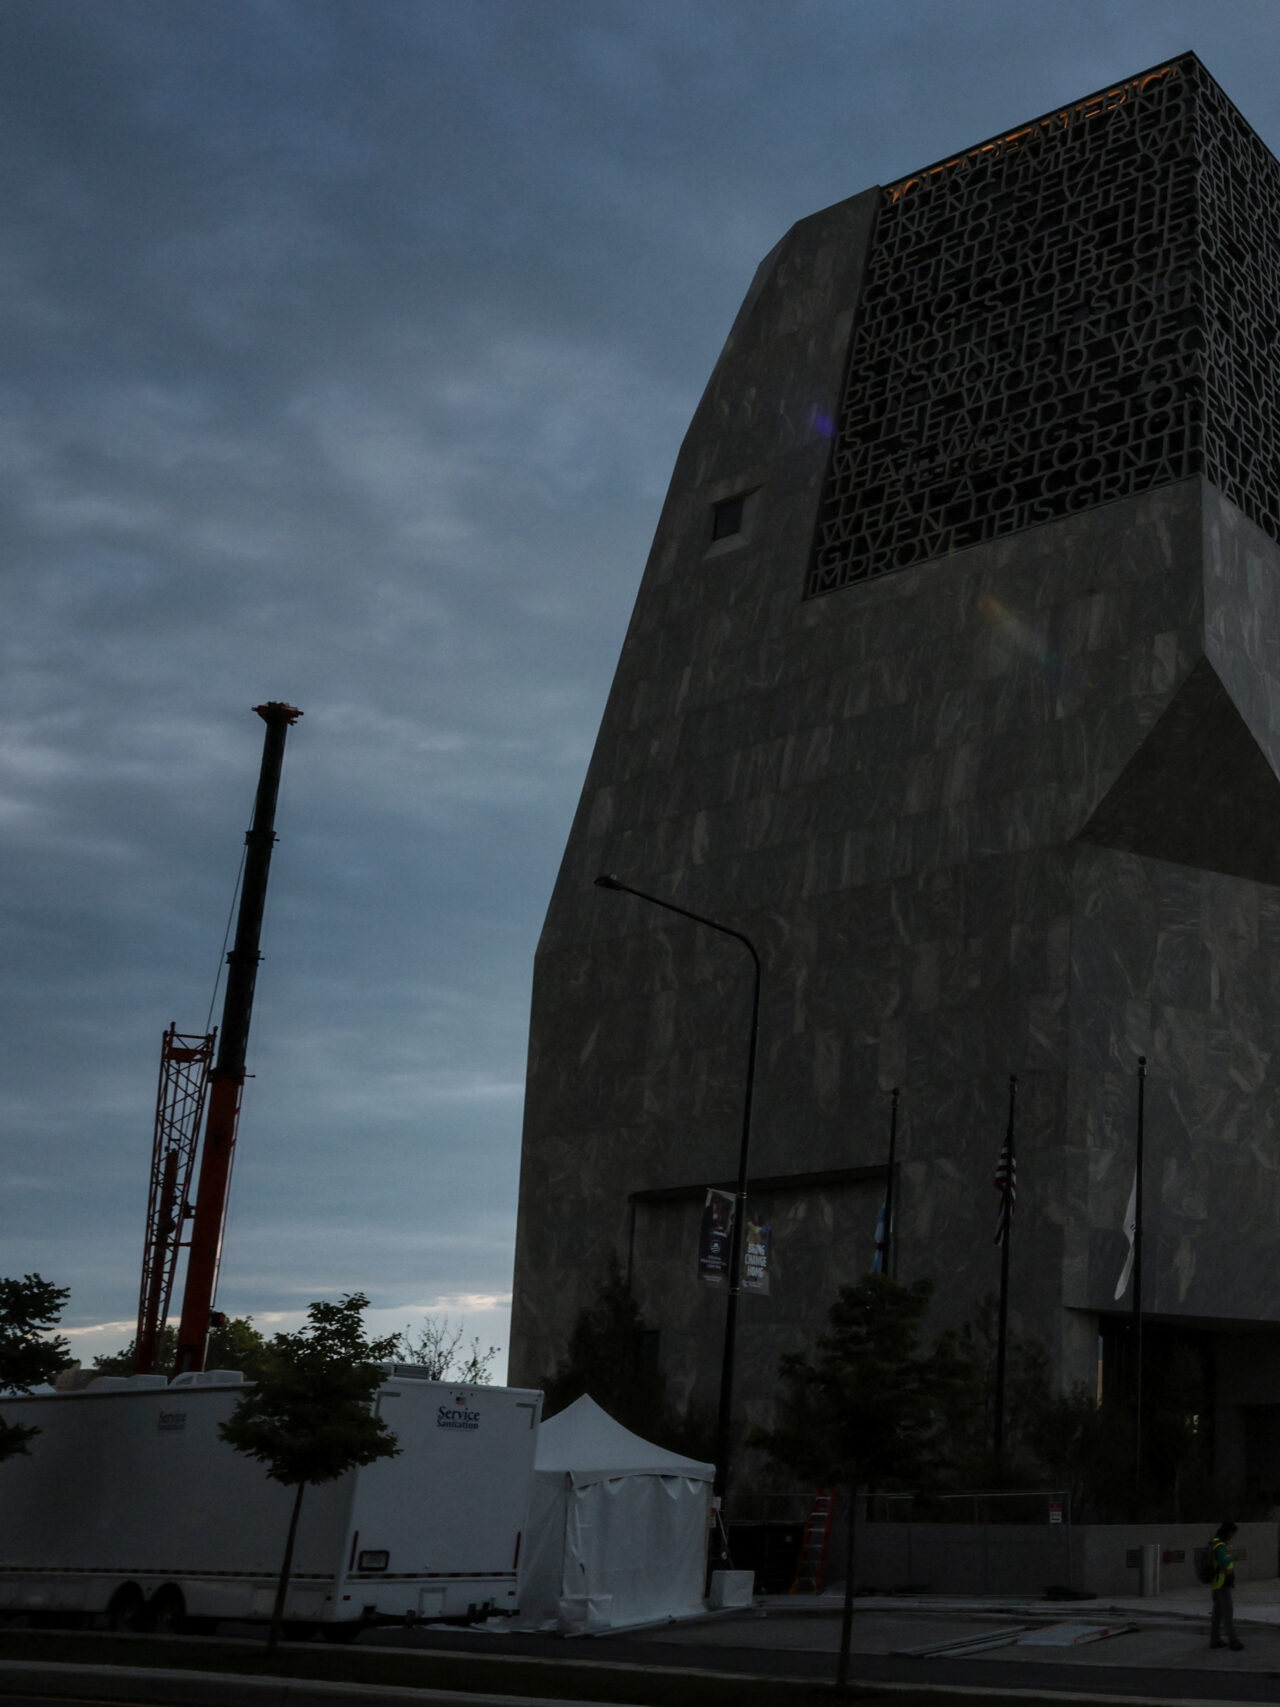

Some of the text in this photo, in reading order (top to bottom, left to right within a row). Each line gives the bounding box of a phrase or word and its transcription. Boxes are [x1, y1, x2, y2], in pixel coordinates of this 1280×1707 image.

[869, 219, 937, 267] ADY
[943, 196, 993, 237] TO
[1012, 143, 1120, 209] SEIZE
[873, 96, 1185, 247] UNENCUMBERED
[876, 191, 920, 229] ED
[928, 168, 973, 207] BY
[986, 115, 1097, 182] HABIT
[1104, 76, 1188, 132] AND
[855, 288, 902, 328] TO
[911, 265, 960, 306] BE
[961, 212, 1093, 286] TAKEN
[861, 211, 1044, 306] COUNTRY
[1051, 152, 1190, 231] THERE
[872, 245, 920, 283] BE
[940, 205, 1017, 256] FOR
[851, 288, 1004, 368] BRIDGES
[1010, 266, 1059, 308] TO
[1076, 241, 1123, 283] BE
[855, 307, 903, 348] ND
[910, 286, 957, 326] TO
[969, 229, 1099, 303] COVER
[888, 324, 964, 374] NOT
[961, 295, 1039, 347] THE
[844, 335, 989, 411] PERSON
[995, 303, 1073, 355] THE
[846, 381, 919, 431] FUL
[932, 335, 1044, 400] WORD
[1064, 311, 1107, 353] IN
[869, 392, 948, 445] THE
[958, 342, 1087, 413] WORD
[1110, 310, 1177, 359] WE
[825, 446, 921, 503] THAT
[935, 397, 1062, 465] WORD
[831, 437, 887, 479] WE
[897, 387, 1024, 456] SHALL
[883, 405, 1100, 504] BELONGS
[1113, 378, 1177, 426] TO
[808, 519, 971, 597] IMPROVE
[971, 491, 1056, 546] THIS
[1064, 445, 1199, 517] GREAT
[815, 505, 945, 572] GIVEN
[958, 481, 1017, 525] TO
[817, 483, 939, 549] WHAT
[437, 1406, 480, 1420] Service
[437, 1420, 479, 1429] Sanitation
